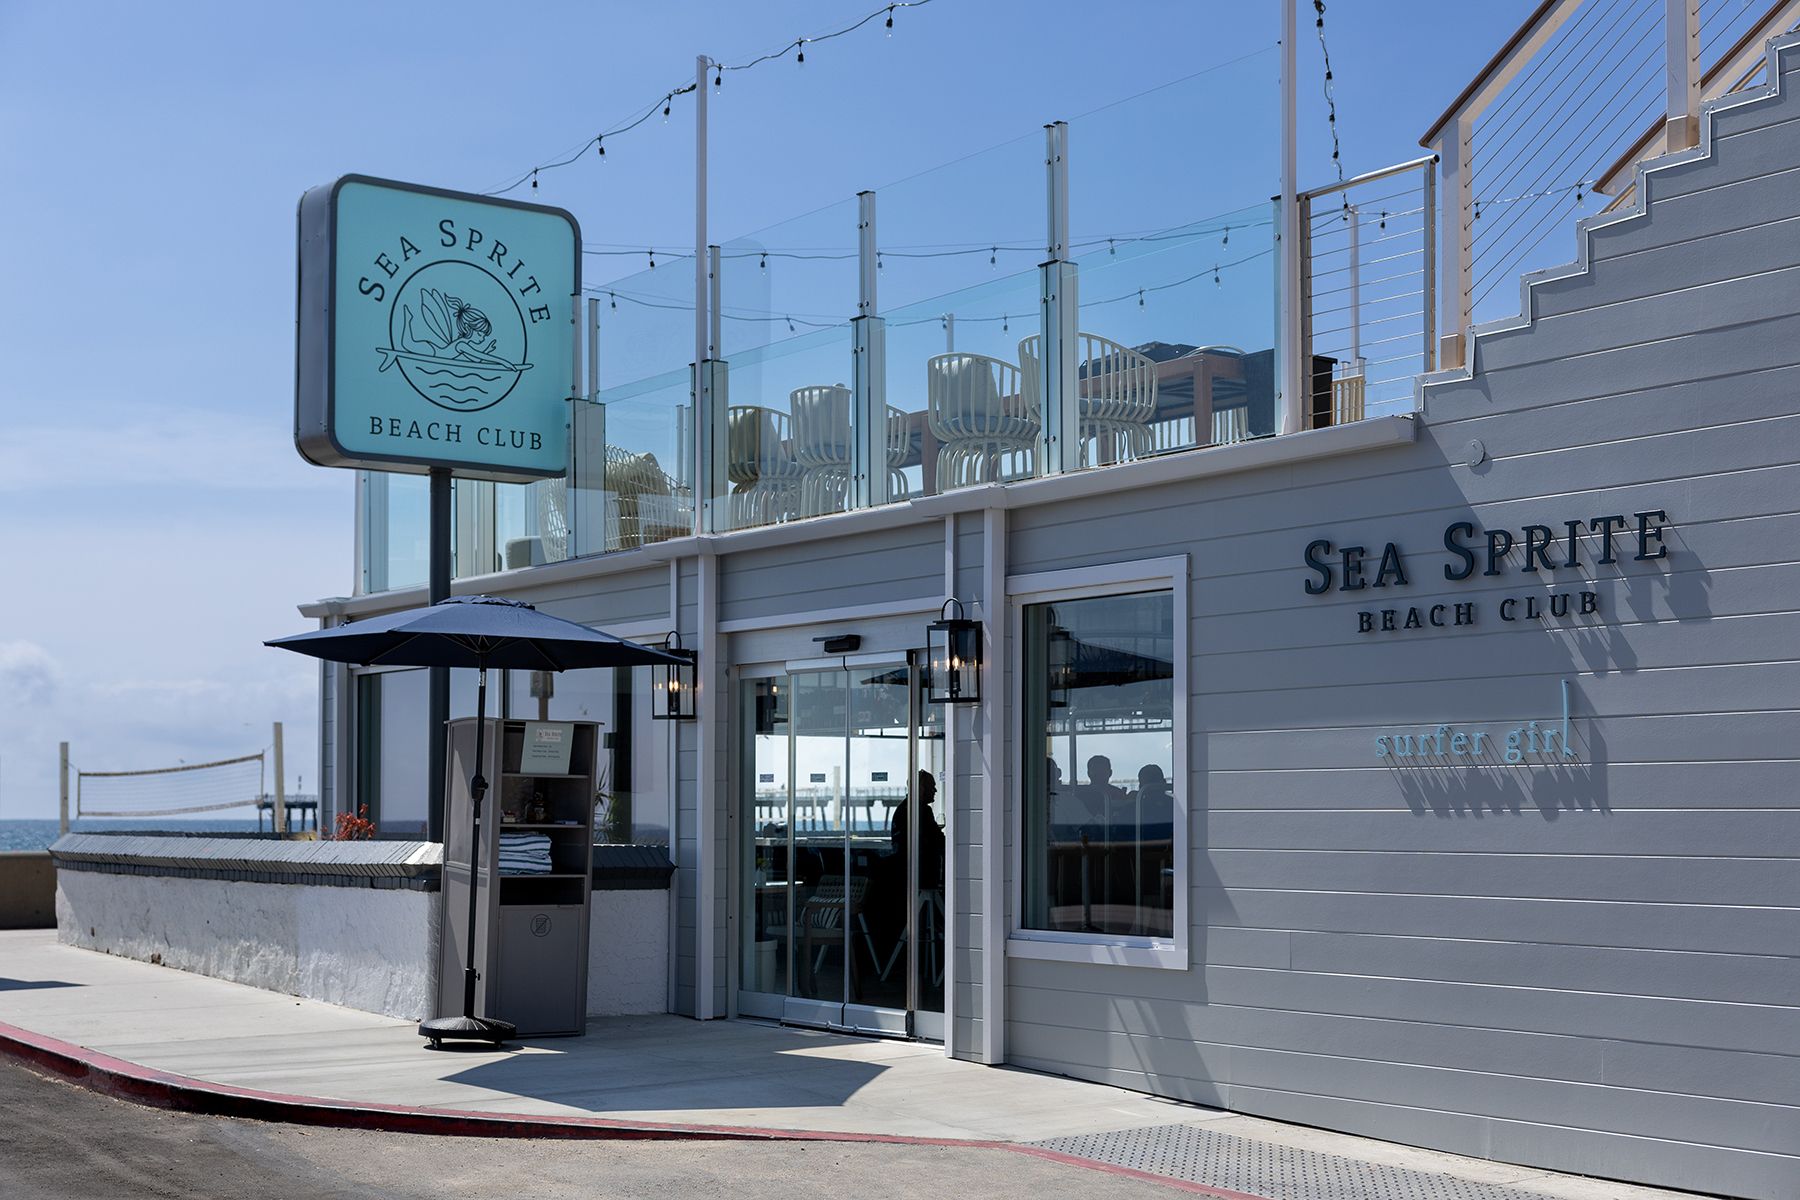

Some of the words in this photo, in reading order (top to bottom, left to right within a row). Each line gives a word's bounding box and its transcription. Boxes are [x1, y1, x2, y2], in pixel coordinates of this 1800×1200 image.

[358, 236, 422, 302] SEA
[438, 219, 551, 323] SPRITE
[369, 416, 462, 443] BEACH
[477, 426, 543, 450] CLUB
[1304, 539, 1408, 595] SEA
[1443, 510, 1667, 581] SPRITE
[1358, 602, 1474, 633] BEACH
[1499, 591, 1598, 622] CLUB
[1375, 724, 1488, 758] surfer
[1504, 679, 1576, 764] girl
